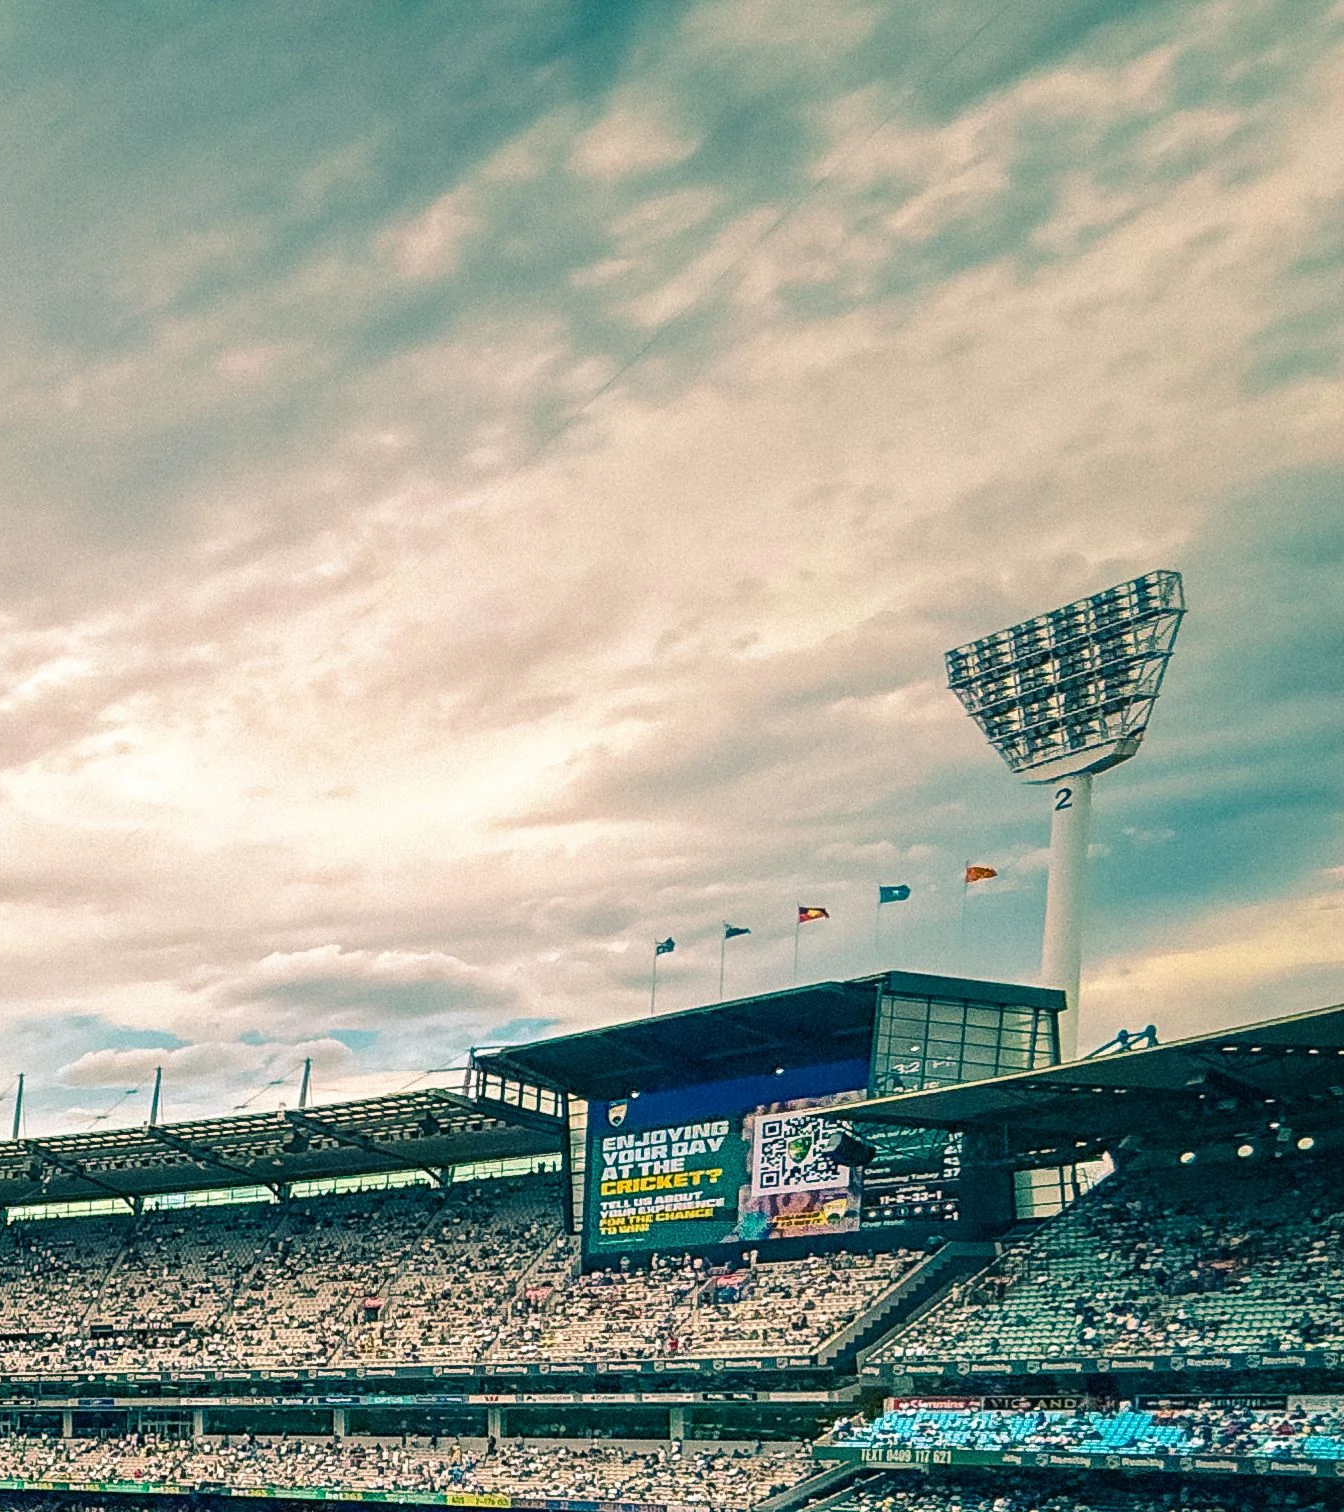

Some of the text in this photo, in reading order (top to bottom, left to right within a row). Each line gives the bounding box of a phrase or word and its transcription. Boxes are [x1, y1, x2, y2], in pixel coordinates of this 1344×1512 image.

[1055, 788, 1073, 811] 2
[602, 1121, 729, 1151] ENJOYING
[602, 1137, 725, 1166] YOUR DAY
[600, 1158, 686, 1182] AT THE
[943, 1167, 961, 1177] 37
[600, 1168, 723, 1196] CRICKET?
[600, 1191, 704, 1211] TELL US ABOUT
[656, 1208, 714, 1222] CHANCE
[860, 1449, 883, 1463] TEXT
[933, 1451, 952, 1465] 621
